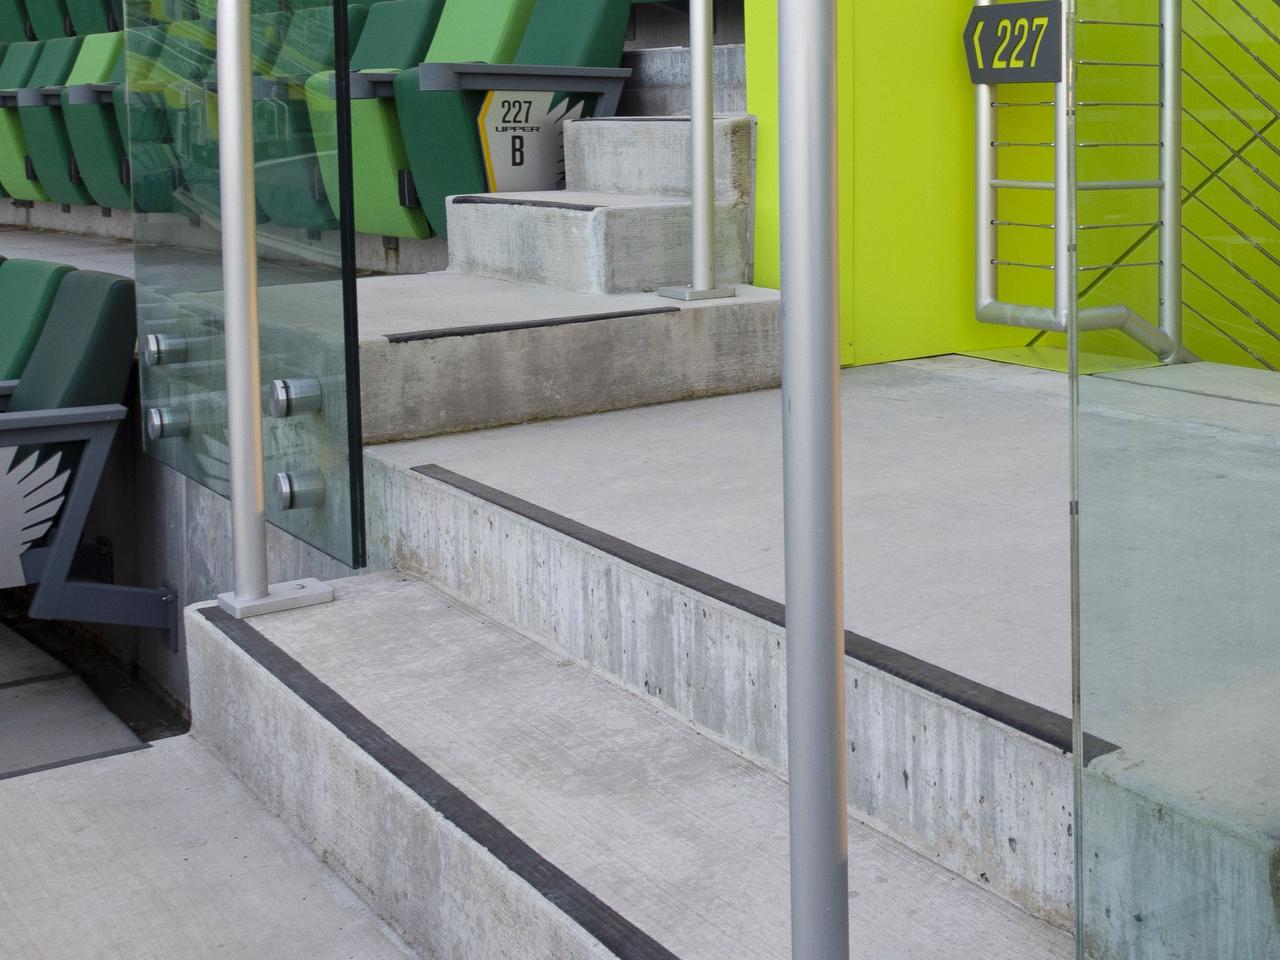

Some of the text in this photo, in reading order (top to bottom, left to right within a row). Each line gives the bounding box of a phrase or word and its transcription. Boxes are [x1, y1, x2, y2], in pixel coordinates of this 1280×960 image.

[992, 16, 1049, 69] 227
[501, 99, 532, 124] 227
[511, 135, 525, 167] B
